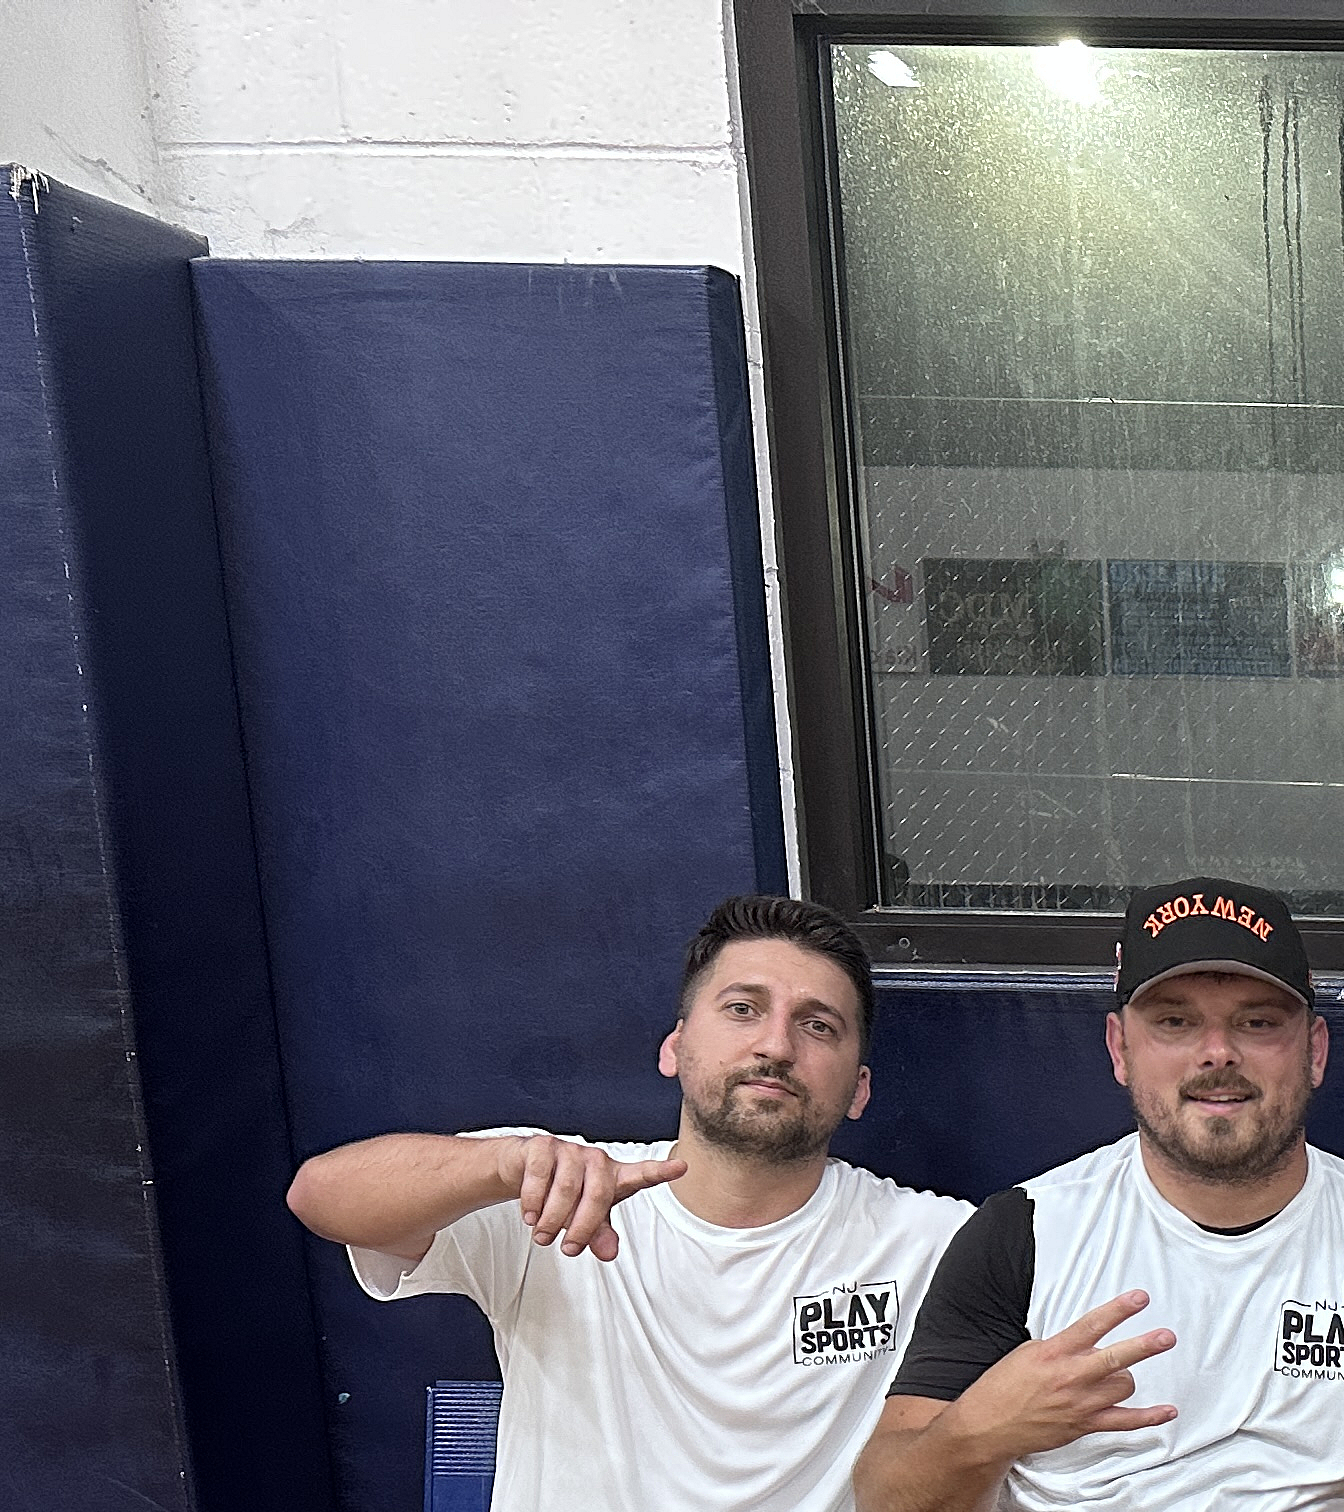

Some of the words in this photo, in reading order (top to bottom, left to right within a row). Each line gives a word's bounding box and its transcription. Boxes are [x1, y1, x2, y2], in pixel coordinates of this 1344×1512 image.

[832, 1281, 858, 1295] NJ
[800, 1291, 890, 1331] PLAY
[1315, 1299, 1338, 1312] NJ
[801, 1323, 893, 1354] SPORTS
[802, 1346, 889, 1367] COMMUNITY
